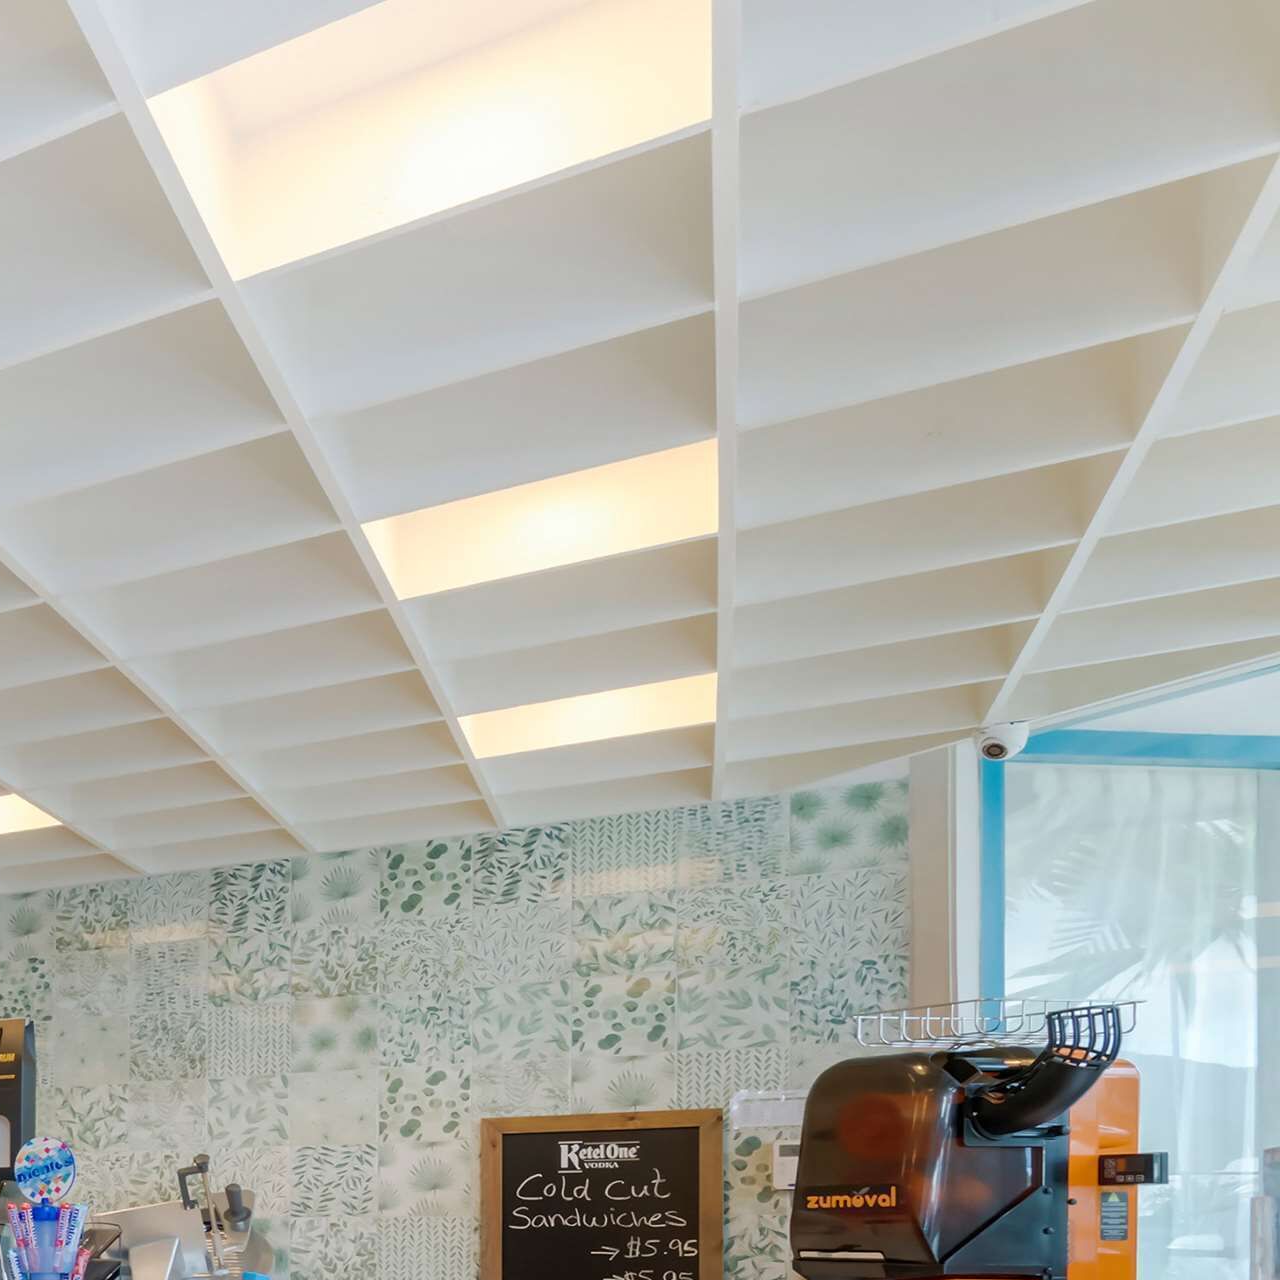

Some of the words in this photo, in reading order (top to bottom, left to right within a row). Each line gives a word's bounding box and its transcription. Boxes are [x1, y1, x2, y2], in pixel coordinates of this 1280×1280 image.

[516, 1173, 592, 1201] Cold
[806, 1185, 897, 1209] zumoval
[508, 1206, 688, 1230] Sandwiches
[624, 1236, 698, 1258] $5.95
